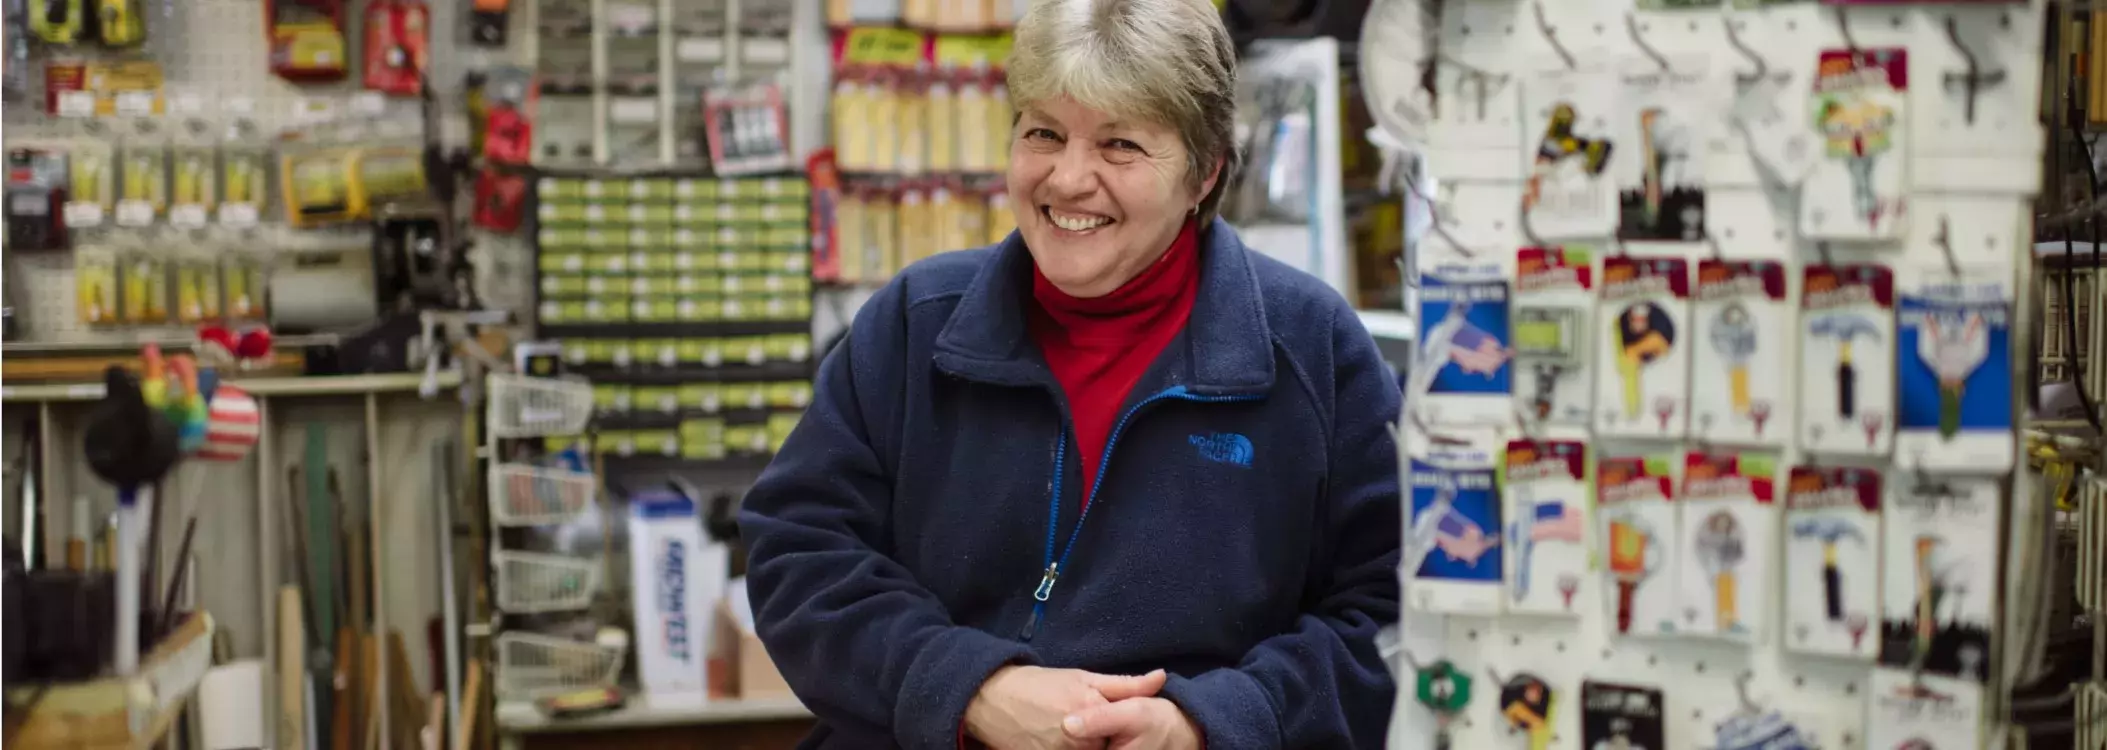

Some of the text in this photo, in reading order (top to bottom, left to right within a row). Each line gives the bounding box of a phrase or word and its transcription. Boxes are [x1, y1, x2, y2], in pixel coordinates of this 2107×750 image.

[1187, 434, 1236, 452] NORTH
[1211, 432, 1236, 443] THE
[1199, 446, 1231, 462] FACE
